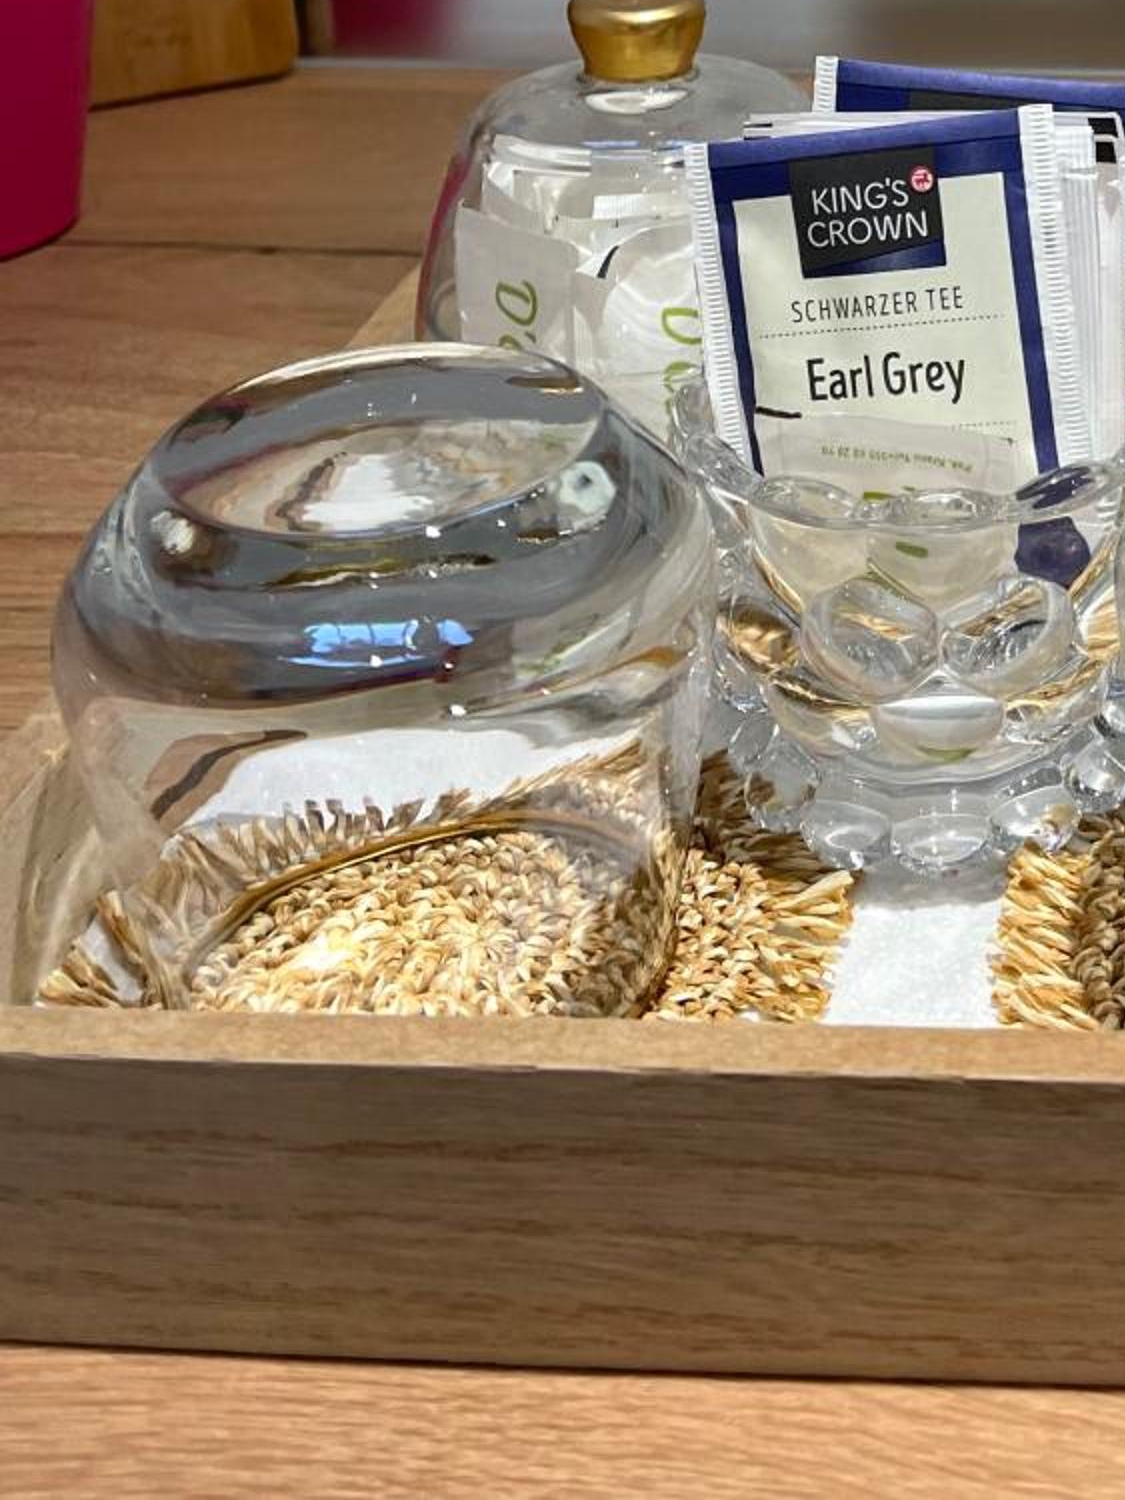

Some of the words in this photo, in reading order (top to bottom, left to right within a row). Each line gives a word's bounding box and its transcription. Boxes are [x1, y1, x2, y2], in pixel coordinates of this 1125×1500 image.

[811, 177, 909, 215] KING'S
[807, 209, 928, 247] CROWN
[791, 291, 918, 323] SCHWARZER
[925, 285, 963, 311] TEE
[806, 355, 874, 401] Earl
[882, 351, 965, 404] Grey
